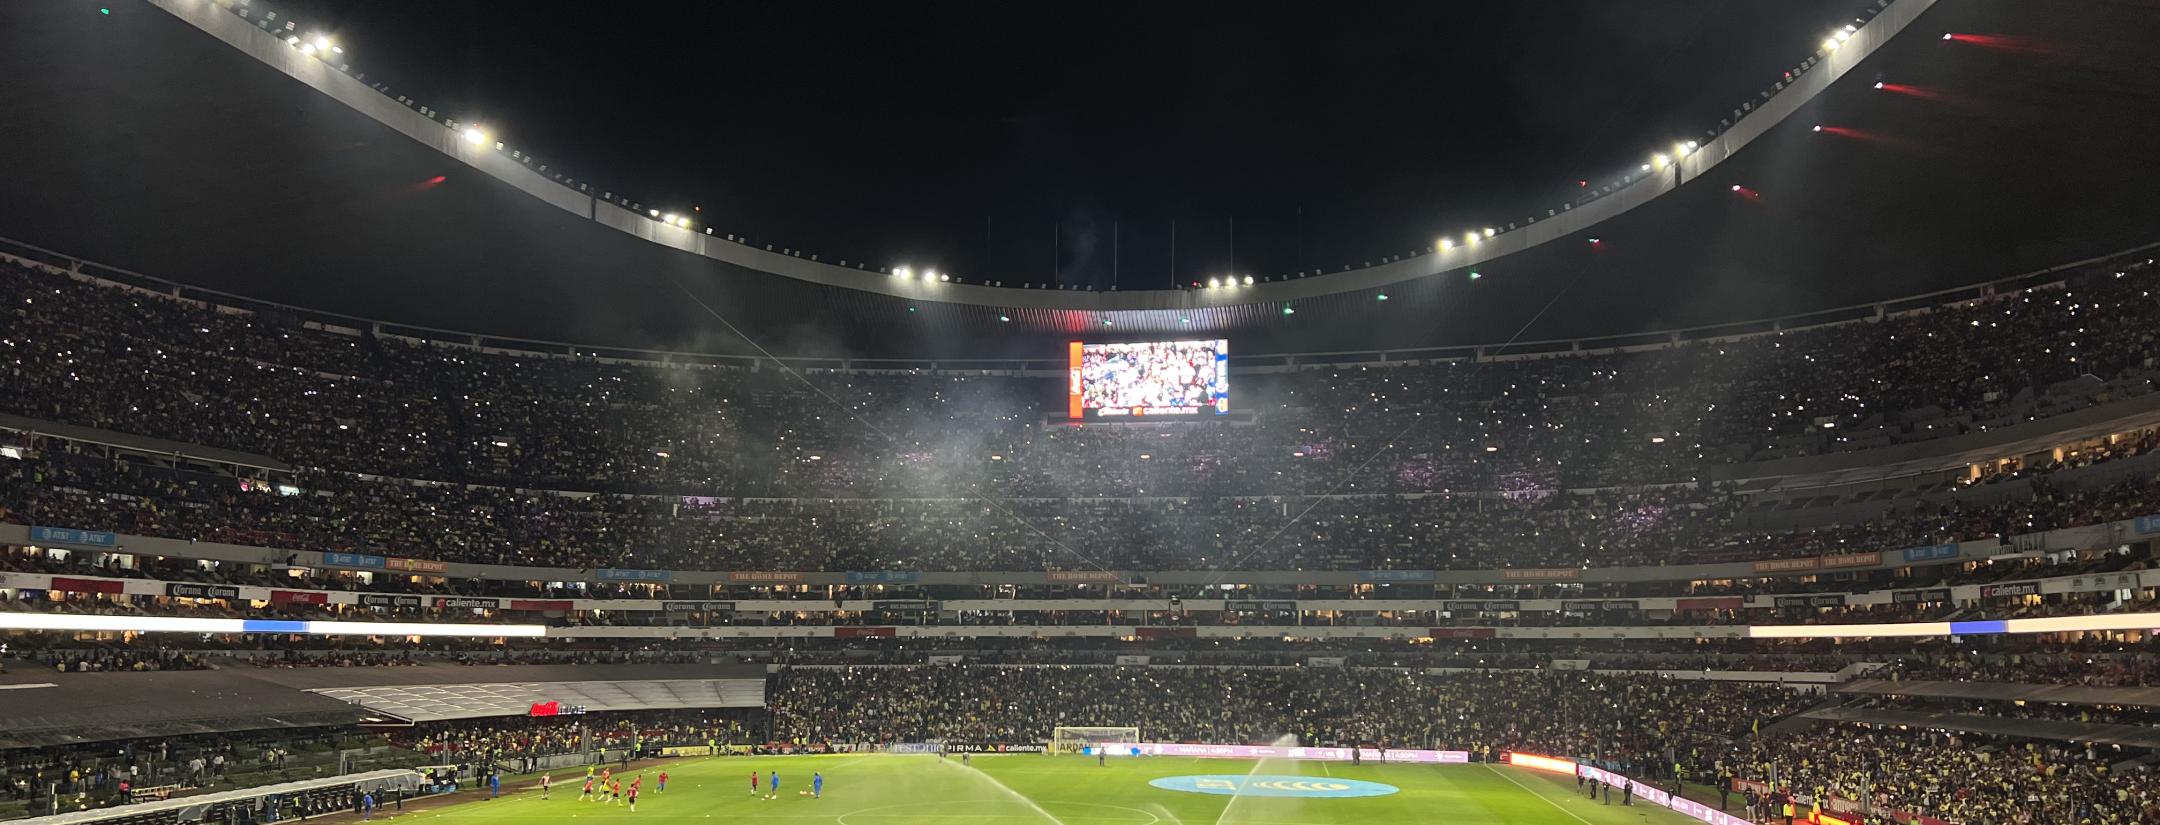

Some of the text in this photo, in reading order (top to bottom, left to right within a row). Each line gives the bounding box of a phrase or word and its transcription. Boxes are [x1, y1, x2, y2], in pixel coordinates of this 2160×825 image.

[52, 530, 105, 543] AT&T AT&T
[173, 584, 235, 598] Corona Corona
[1991, 584, 2036, 597] caliente.mx
[364, 595, 389, 605] Corona
[446, 597, 496, 608] caliente.mx
[666, 602, 696, 611] Corona
